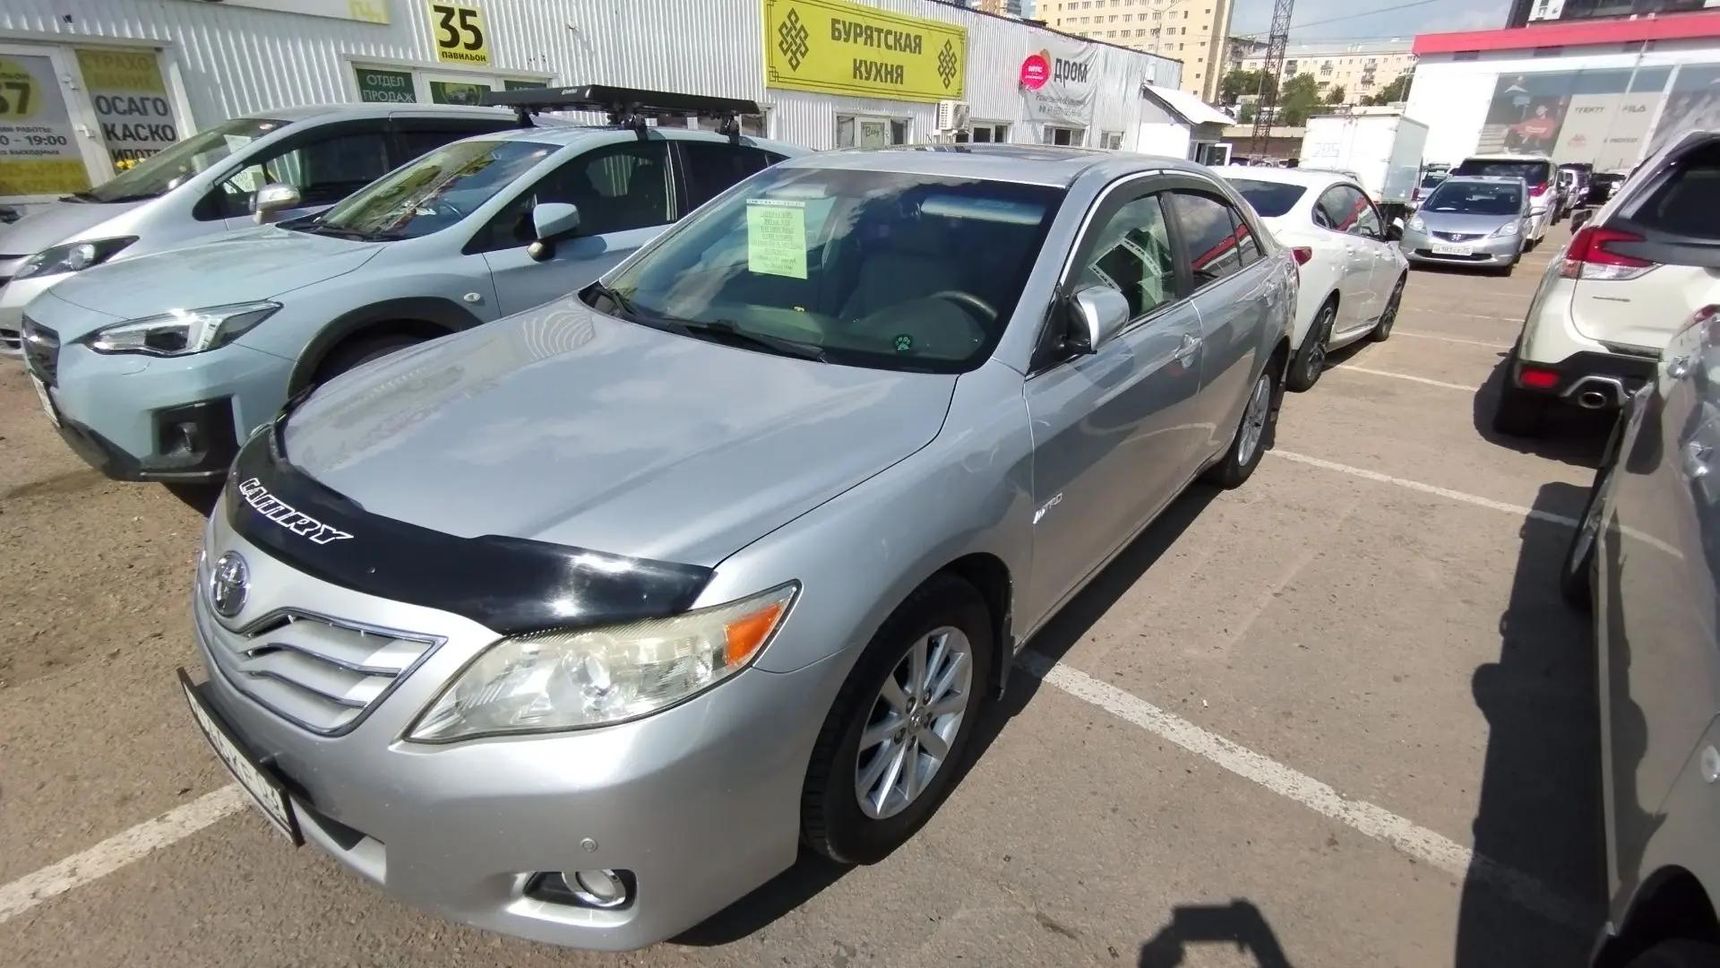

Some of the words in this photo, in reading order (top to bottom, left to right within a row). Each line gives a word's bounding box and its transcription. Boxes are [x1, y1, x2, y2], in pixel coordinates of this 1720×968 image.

[433, 4, 484, 51] 35
[830, 17, 923, 55] БУРЯТСКАЯ
[366, 74, 406, 89] ОТДЕЛ
[852, 58, 905, 85] КУХНЯ
[95, 95, 169, 117] ОСАГО
[362, 89, 416, 103] ПРОДАЖ
[24, 134, 68, 147] 19:00
[102, 122, 177, 142] КАСКО
[238, 477, 355, 545] CAMRY
